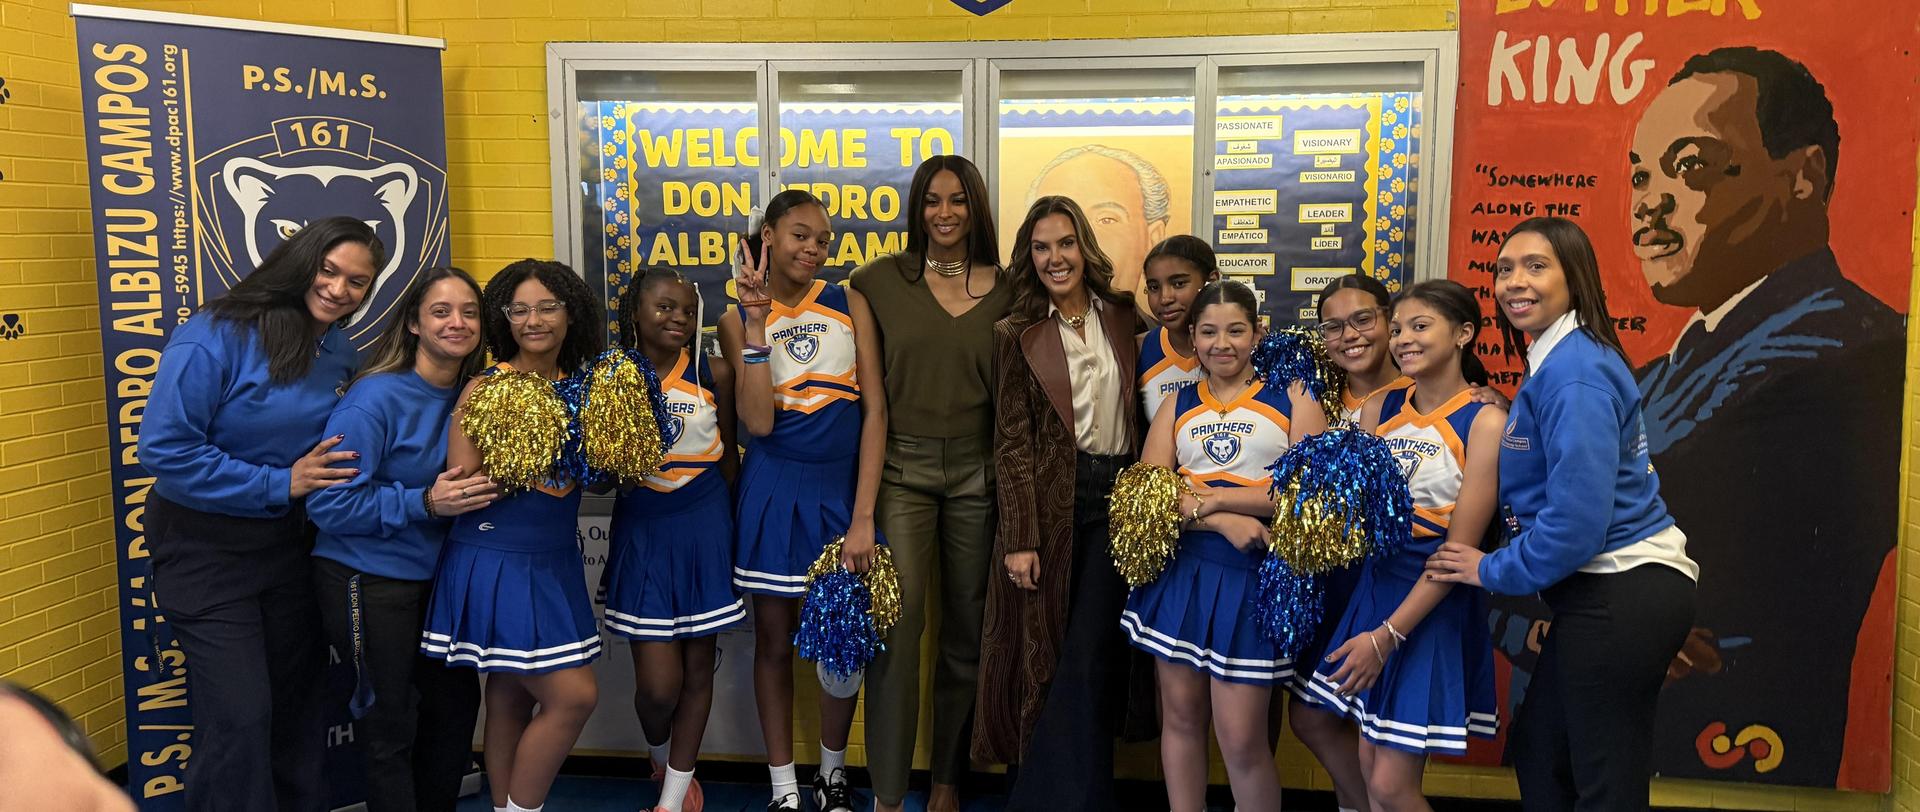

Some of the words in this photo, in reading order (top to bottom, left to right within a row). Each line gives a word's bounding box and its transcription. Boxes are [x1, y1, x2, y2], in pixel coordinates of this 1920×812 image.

[1488, 31, 1655, 106] KING
[243, 65, 387, 100] P.S./M.S.
[92, 42, 156, 196] CAMPOS
[1216, 121, 1274, 130] PASSIONATE
[290, 121, 349, 149] 161
[1302, 138, 1352, 148] VISIONARY
[163, 44, 190, 250] https://www.dpac161.org
[890, 127, 955, 168] TO
[1216, 157, 1270, 165] APASIONADO
[1304, 173, 1352, 181] VISIONARIO
[662, 181, 751, 217] DON
[1215, 197, 1271, 207] EMPATHETIC
[1307, 209, 1345, 218] LEADER
[1471, 202, 1536, 217] ALONG
[1544, 203, 1581, 217] THE
[1221, 231, 1264, 240] EMPÁTICO
[1314, 239, 1339, 248] LÍDER
[1218, 258, 1268, 267] EDUCATOR
[105, 208, 164, 337] ALBIZU
[1304, 276, 1336, 285] ORATO
[772, 323, 828, 342] PANTHERS
[1191, 422, 1254, 439] PANTHERS
[350, 592, 358, 608] DON
[351, 608, 359, 633] PEDRO
